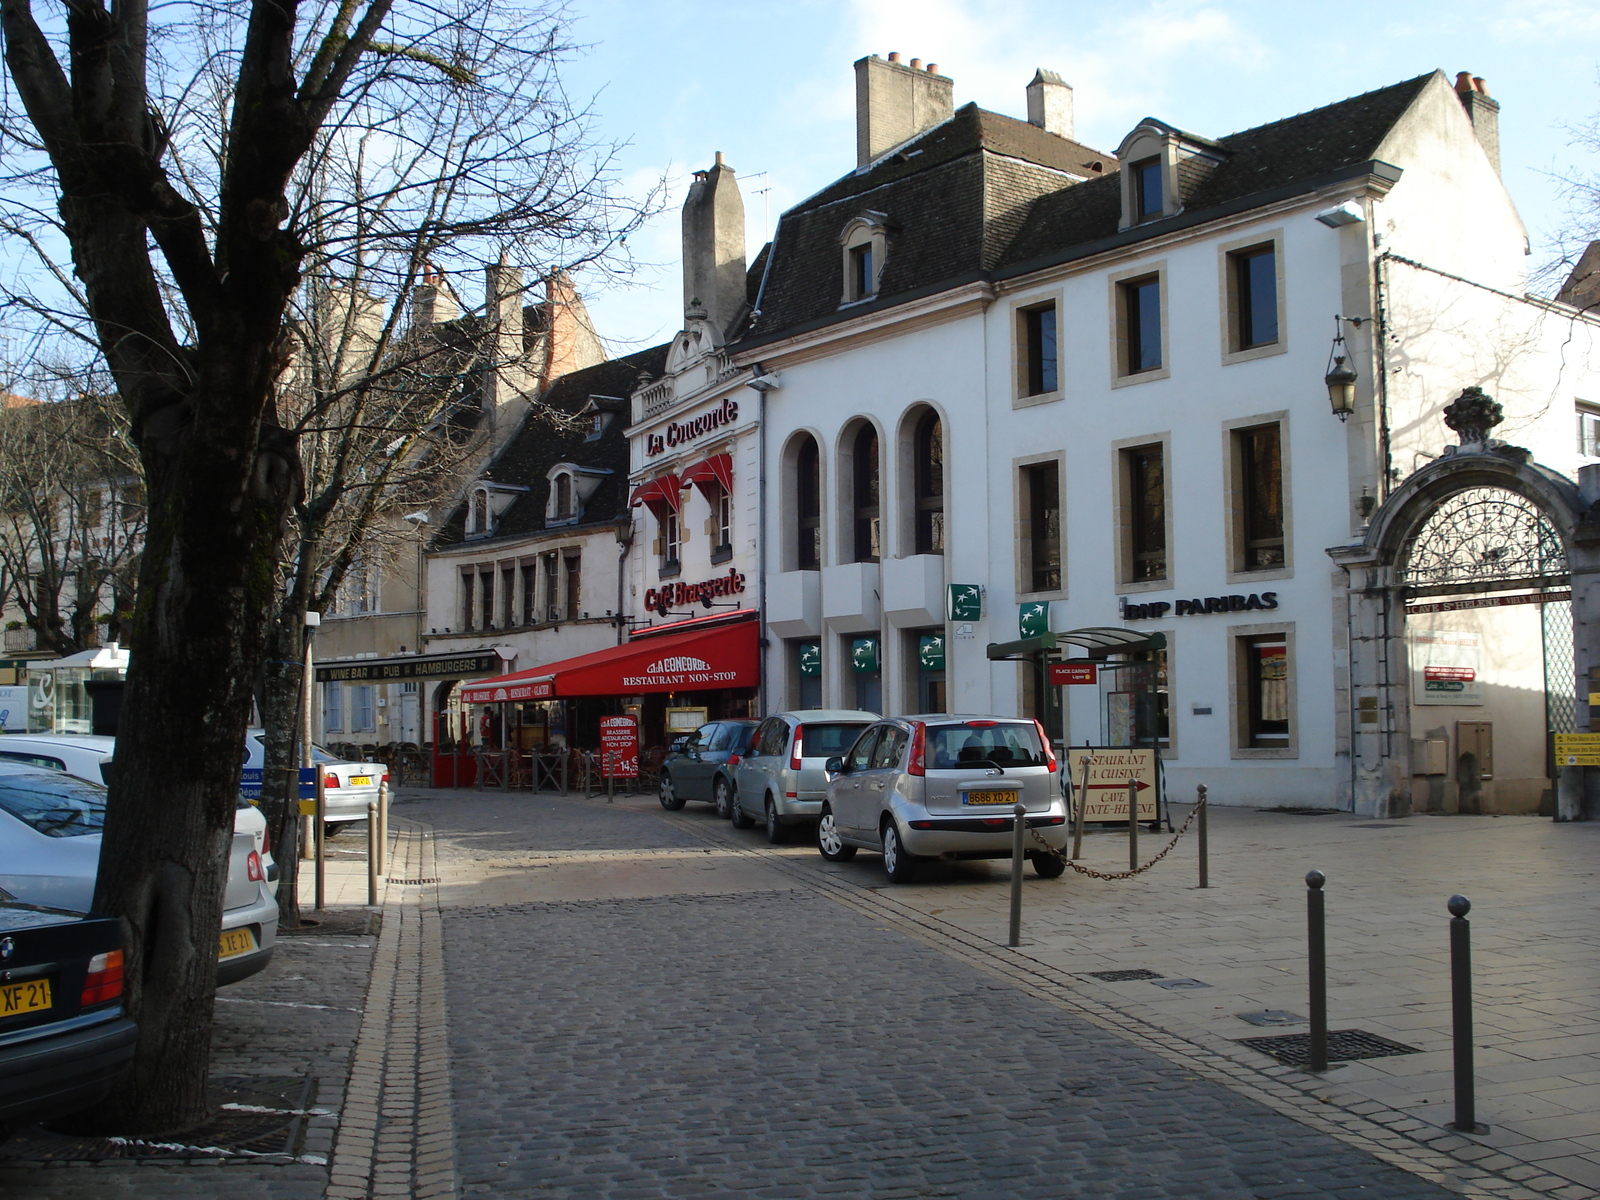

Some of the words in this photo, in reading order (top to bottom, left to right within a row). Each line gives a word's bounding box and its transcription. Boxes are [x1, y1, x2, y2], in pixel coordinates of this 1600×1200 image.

[646, 433, 665, 456] La
[666, 398, 738, 447] Concorde
[674, 568, 745, 606] Brasserie
[1124, 601, 1171, 620] BNP
[1175, 592, 1279, 616] PARIBAS
[1411, 602, 1440, 614] CAVE
[383, 665, 400, 677] PUB
[415, 659, 476, 675] HAMBURGERS
[664, 656, 711, 673] CONCORDE
[330, 668, 350, 680] WINE
[351, 667, 368, 679] BAR
[623, 674, 685, 686] RESTAURANT
[688, 671, 737, 683] NON-STOP
[1078, 755, 1146, 766] RSTAURANT
[240, 771, 259, 780] ouis
[1078, 768, 1097, 779] "A
[969, 792, 991, 803] 8686
[993, 791, 1004, 801] XD
[1005, 791, 1015, 801] 21
[1101, 792, 1126, 802] CAVE
[1072, 803, 1154, 816] SINTE-HEENE
[226, 935, 237, 950] XE
[238, 933, 250, 948] 21
[3, 987, 23, 1012] XF
[27, 982, 46, 1008] 21
